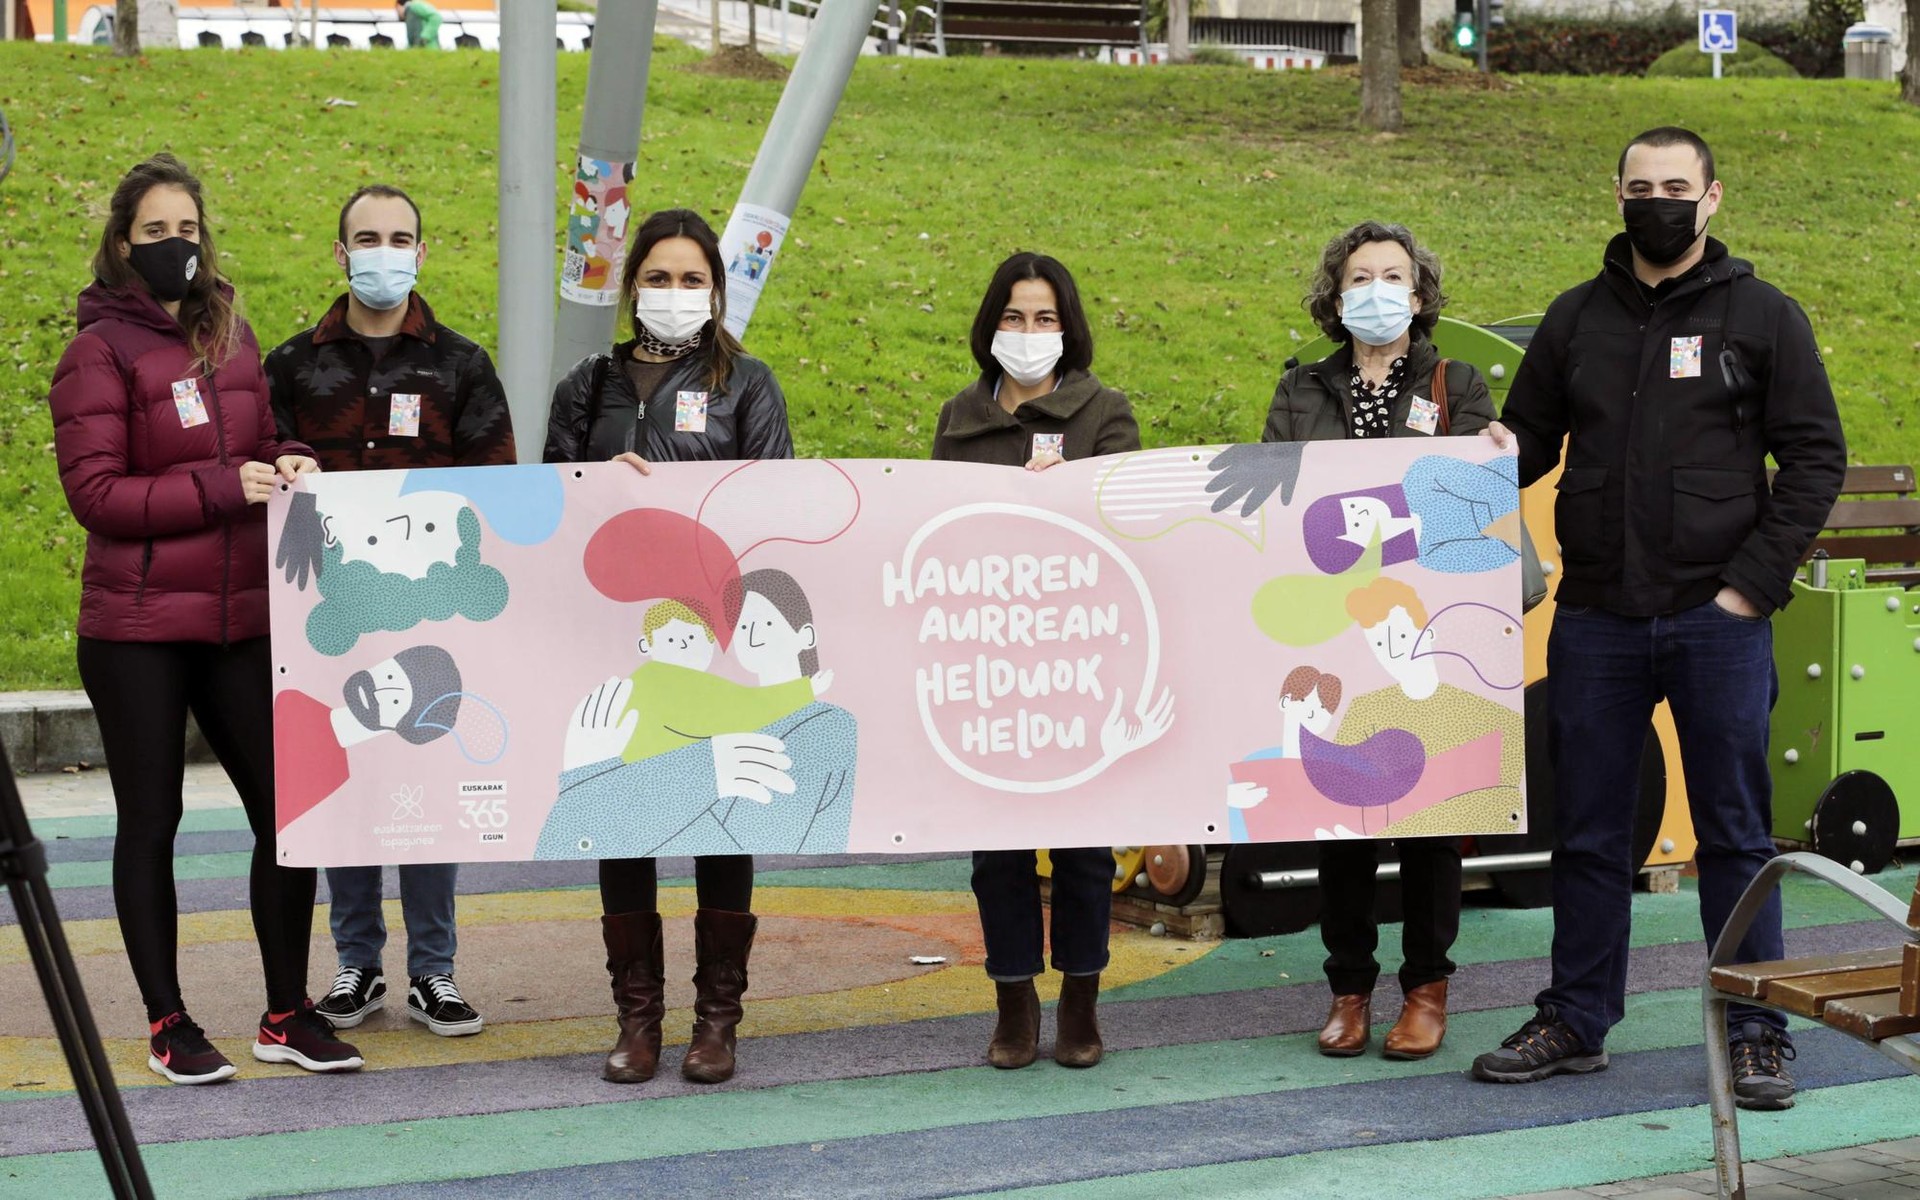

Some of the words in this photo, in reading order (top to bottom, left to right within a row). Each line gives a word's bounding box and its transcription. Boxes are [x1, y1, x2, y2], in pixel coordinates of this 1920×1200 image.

[883, 553, 1099, 607] HAURREN
[918, 603, 1130, 648] AURREAN,
[961, 708, 1086, 759] HELDU
[462, 784, 504, 792] EUSKARAK
[458, 799, 509, 829] 365
[482, 833, 504, 841] EGUN
